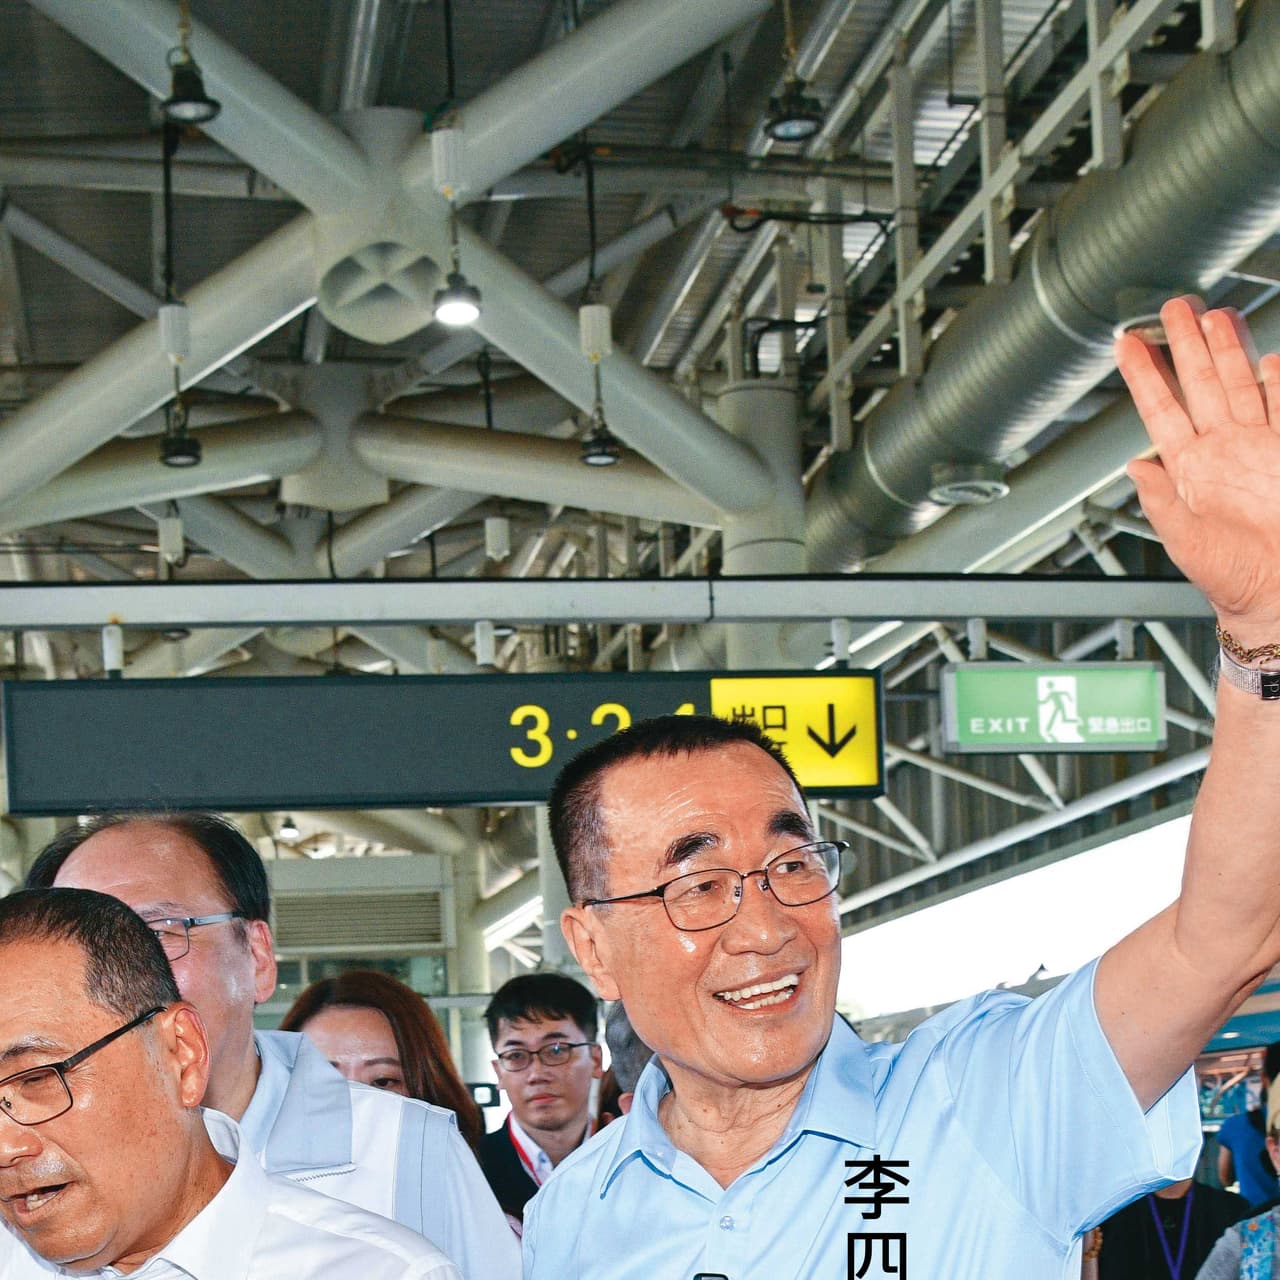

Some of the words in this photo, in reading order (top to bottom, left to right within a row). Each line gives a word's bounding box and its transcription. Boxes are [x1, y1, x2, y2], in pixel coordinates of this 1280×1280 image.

[970, 717, 1030, 734] EXIT
[1087, 716, 1153, 734] 緊急出口
